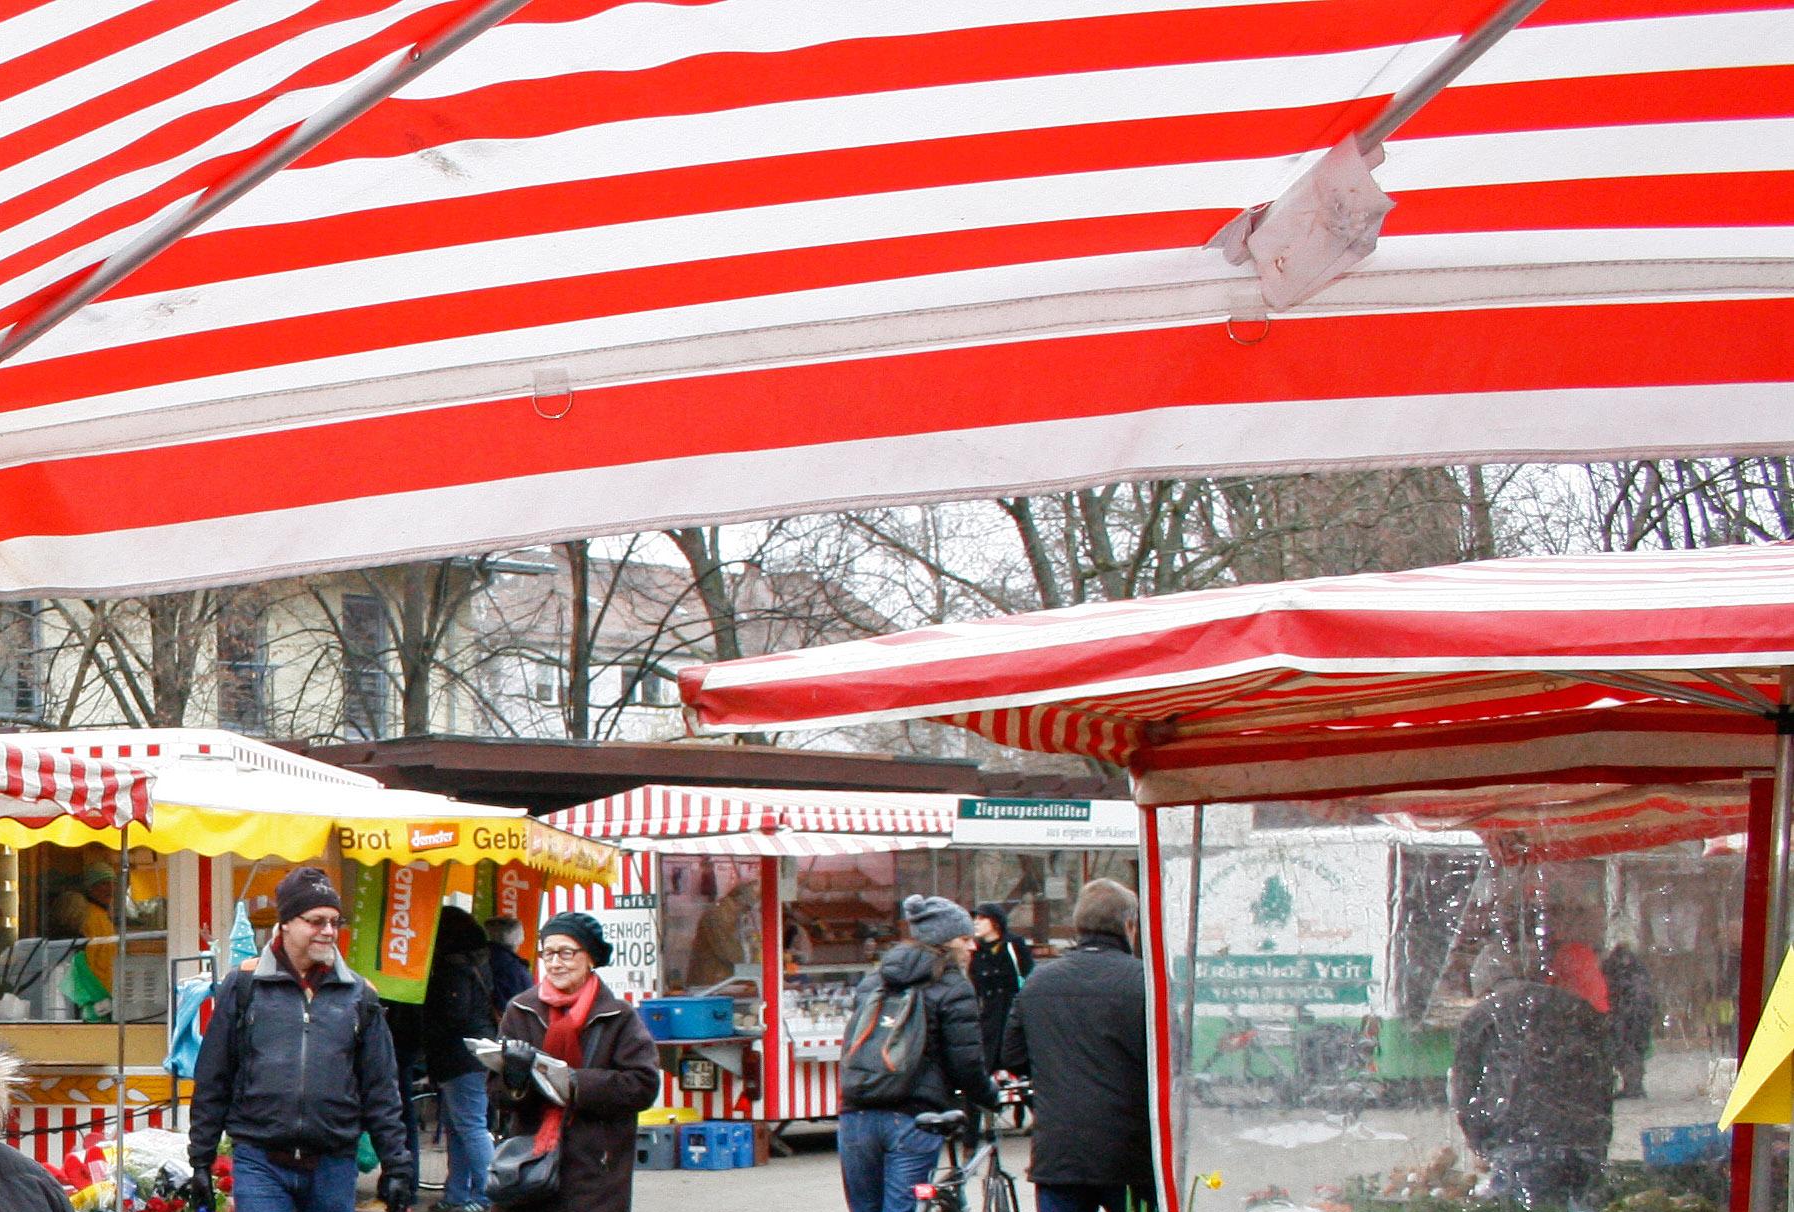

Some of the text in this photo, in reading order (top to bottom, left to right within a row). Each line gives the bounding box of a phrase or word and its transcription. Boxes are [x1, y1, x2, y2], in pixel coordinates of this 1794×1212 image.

[974, 802, 1088, 819] Ziegenspezialitäten
[338, 826, 392, 850] Brot
[410, 829, 455, 847] demeter
